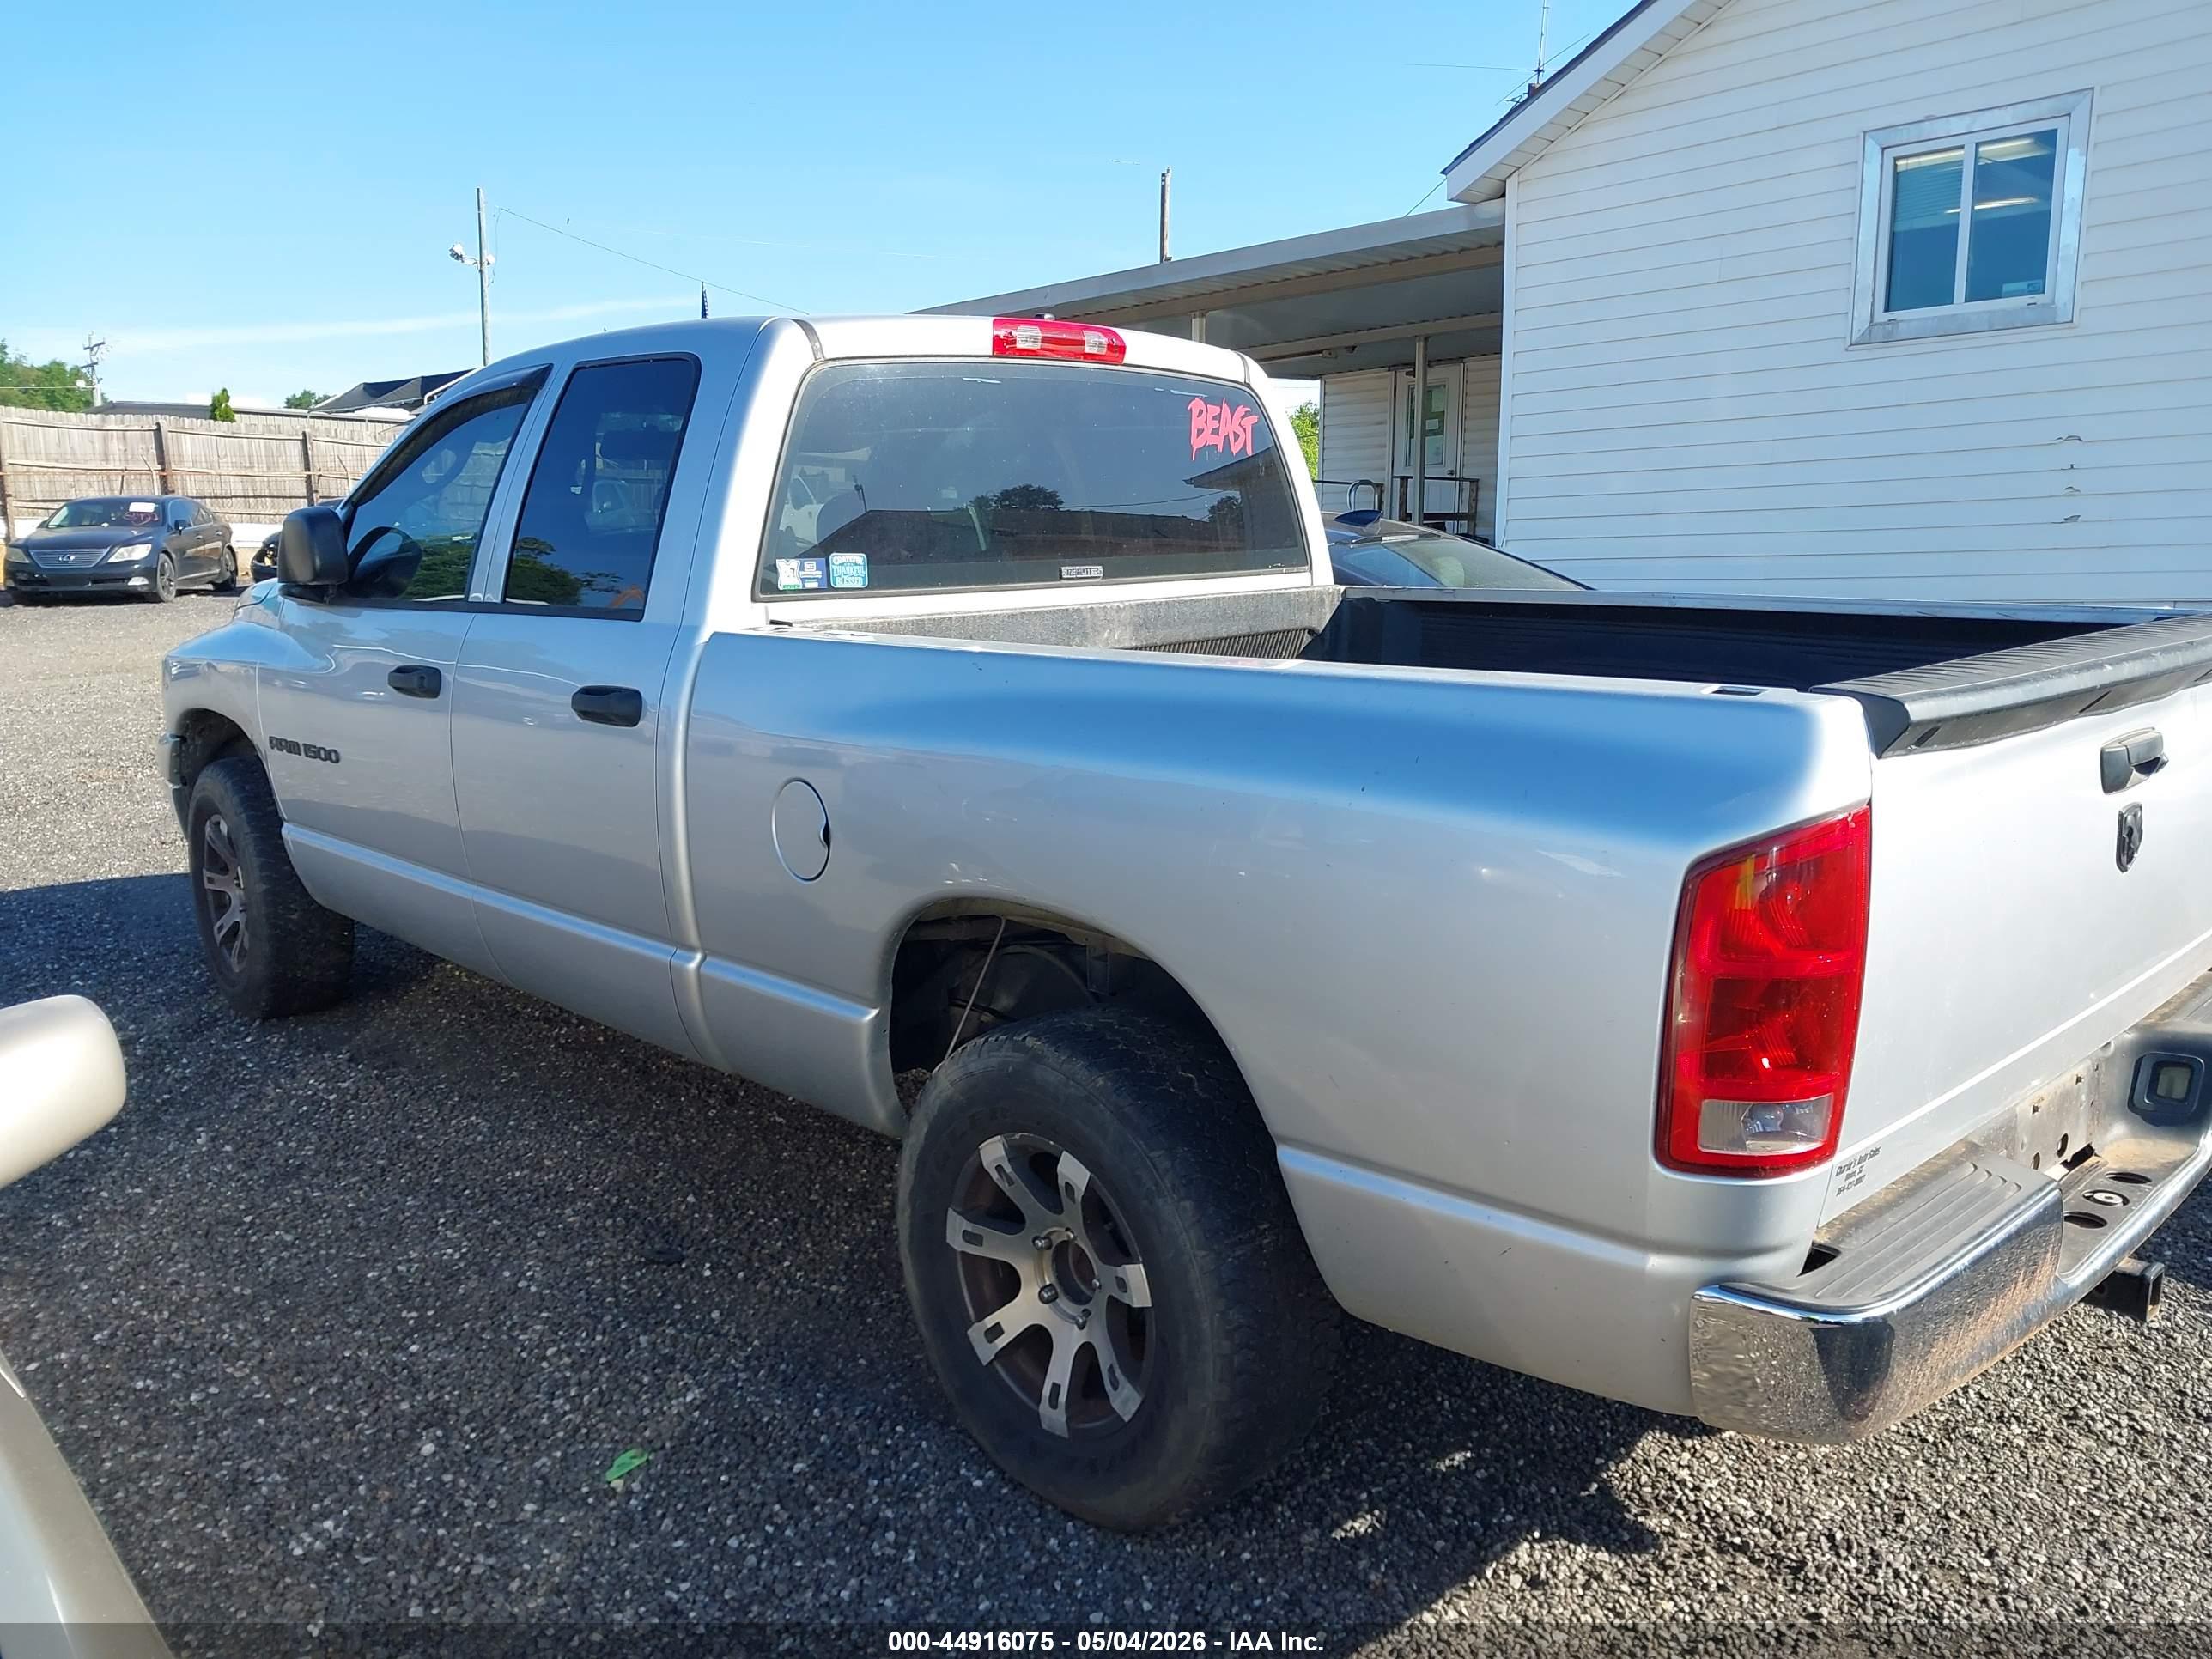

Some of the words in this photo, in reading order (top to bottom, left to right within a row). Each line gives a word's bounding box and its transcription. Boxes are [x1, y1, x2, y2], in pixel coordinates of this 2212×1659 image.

[1188, 398, 1259, 461] BEAST
[269, 736, 301, 756] RAM
[302, 743, 340, 763] 1500
